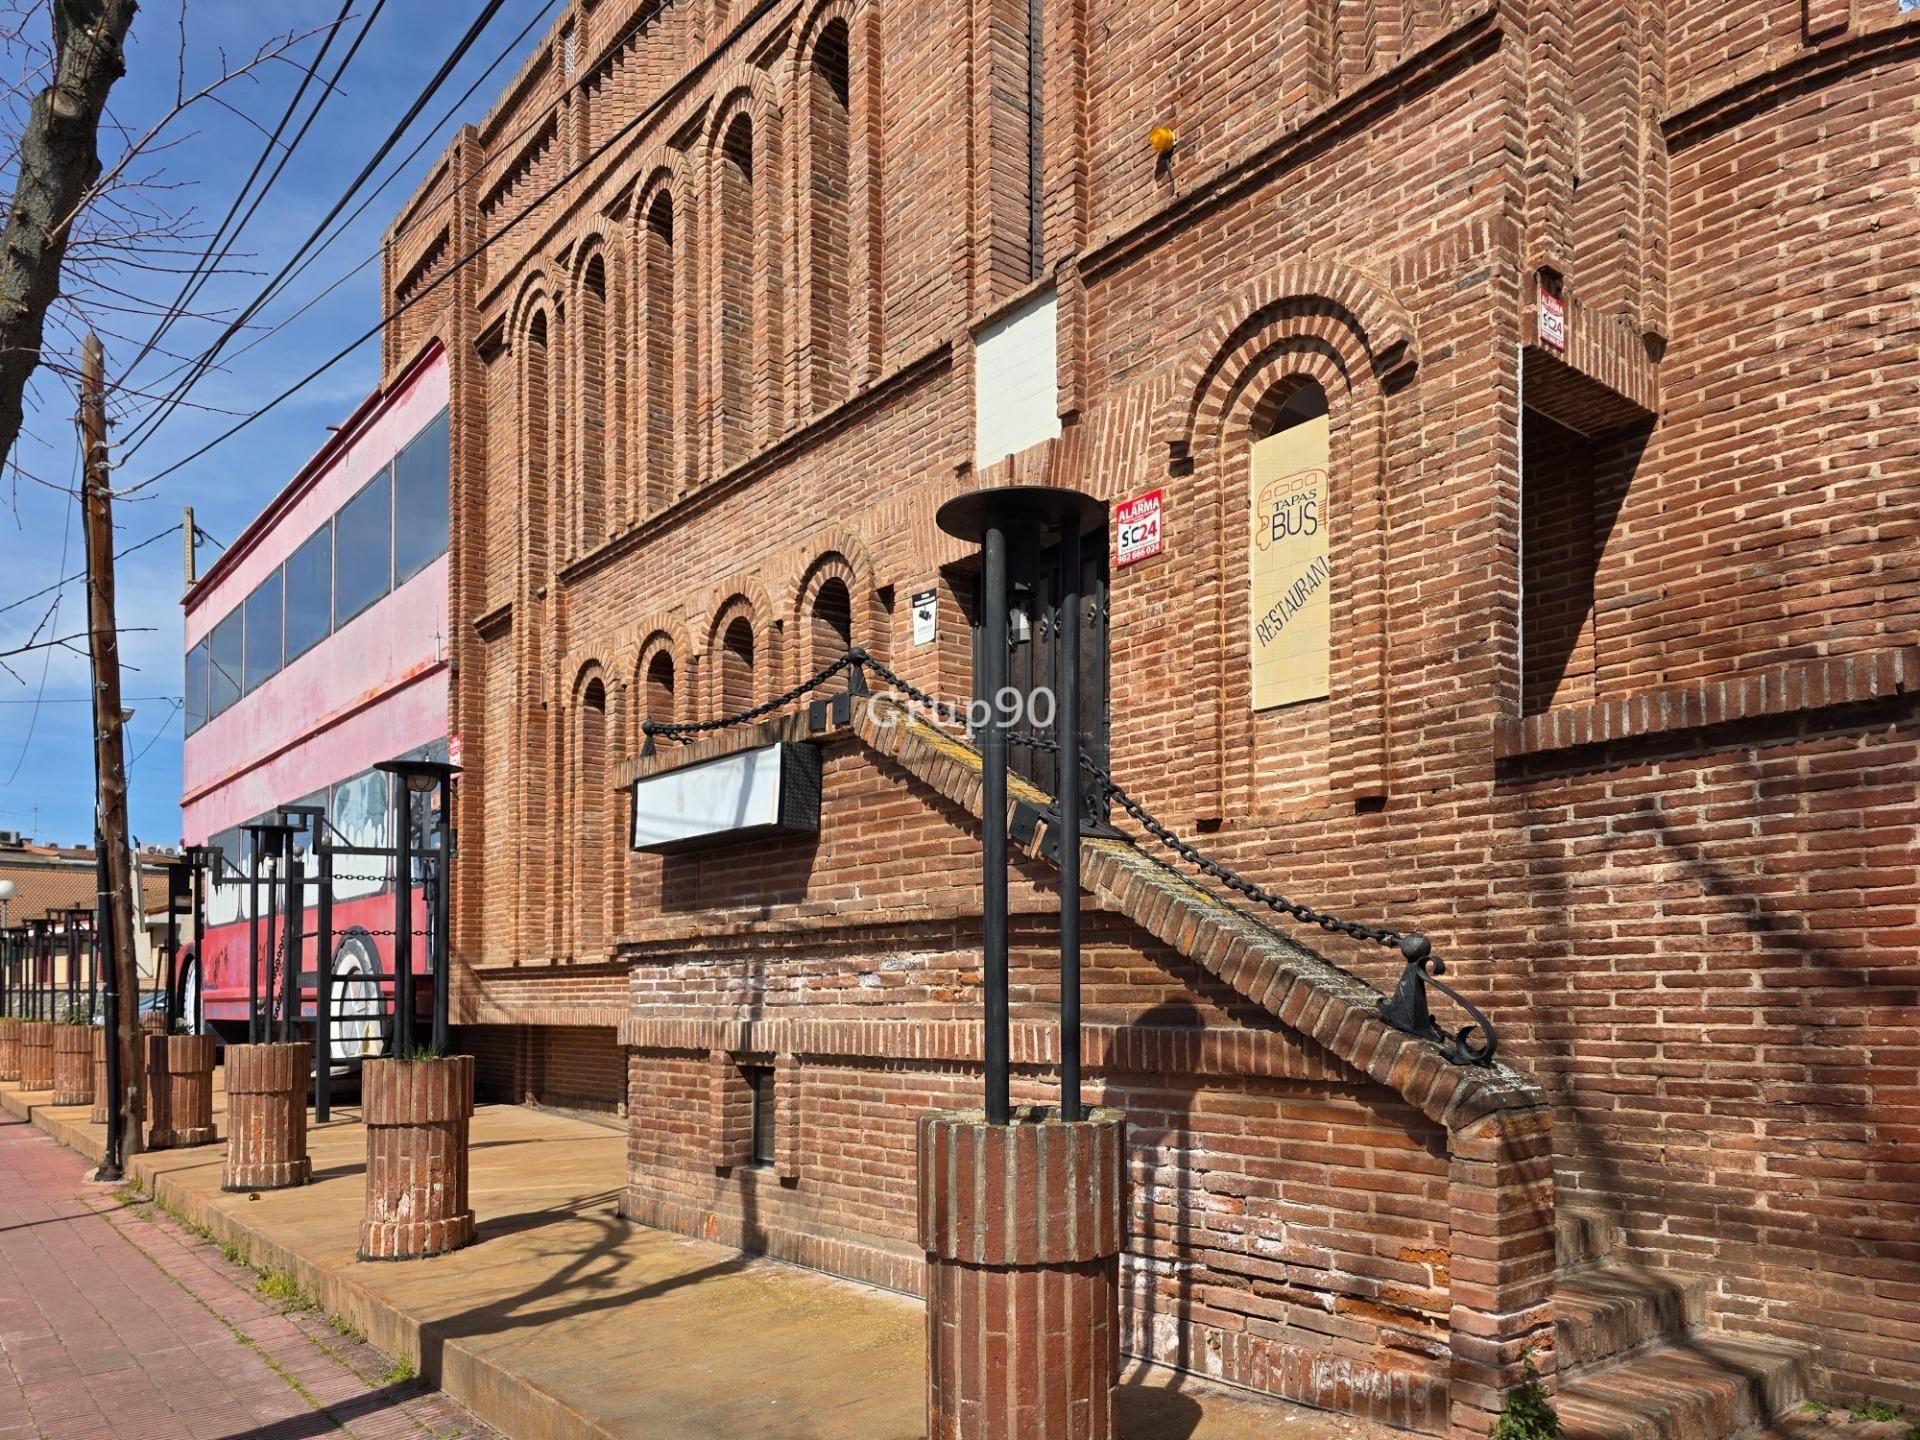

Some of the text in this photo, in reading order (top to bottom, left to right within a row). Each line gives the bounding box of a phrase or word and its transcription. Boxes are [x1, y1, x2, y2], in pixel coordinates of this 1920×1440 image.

[1119, 496, 1160, 522] ALARMA
[1273, 489, 1317, 512] TAPAS
[1121, 520, 1158, 548] SC24
[1272, 501, 1318, 541] BUS
